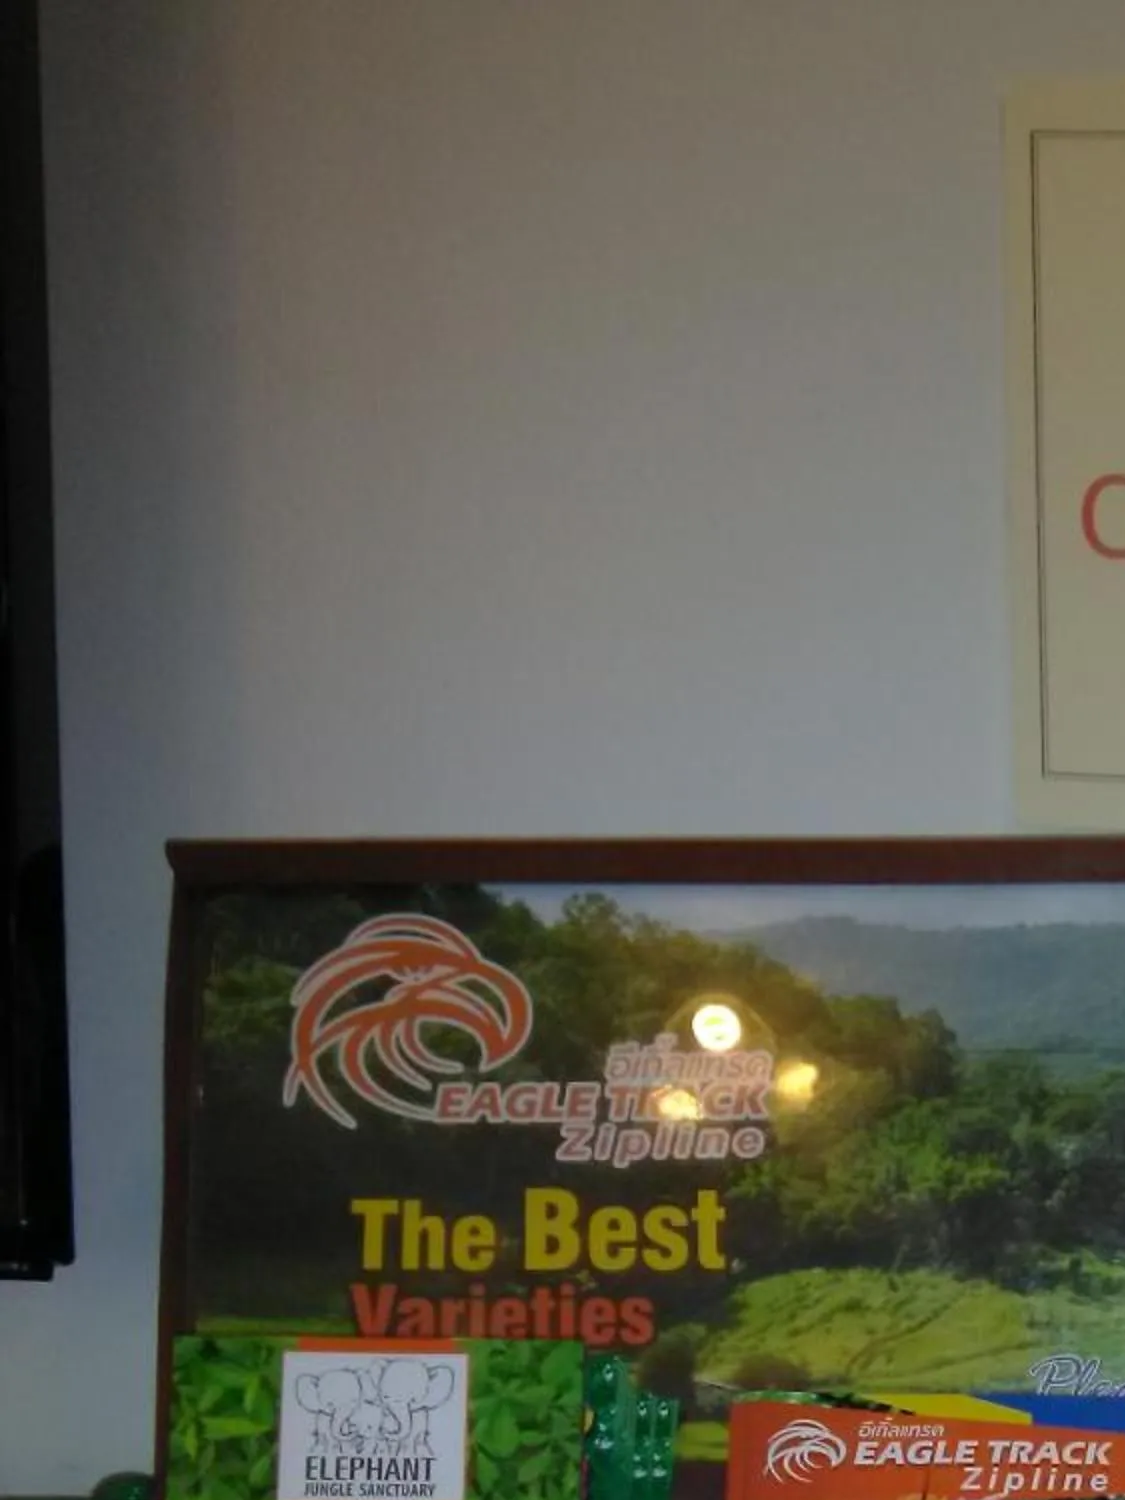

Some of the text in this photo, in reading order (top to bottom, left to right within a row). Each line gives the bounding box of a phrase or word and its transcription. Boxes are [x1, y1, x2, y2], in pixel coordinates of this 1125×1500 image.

[433, 1082, 768, 1123] EAGLE TRCK
[555, 1122, 765, 1168] Zipline
[351, 1187, 727, 1271] The Best
[350, 1283, 656, 1346] Varieties
[304, 1455, 437, 1483] ELEPHANT
[854, 1440, 1113, 1466] EAGLE TRACK
[304, 1481, 437, 1498] JUNGLE SANCTUARY
[960, 1466, 1110, 1494] Zipline
